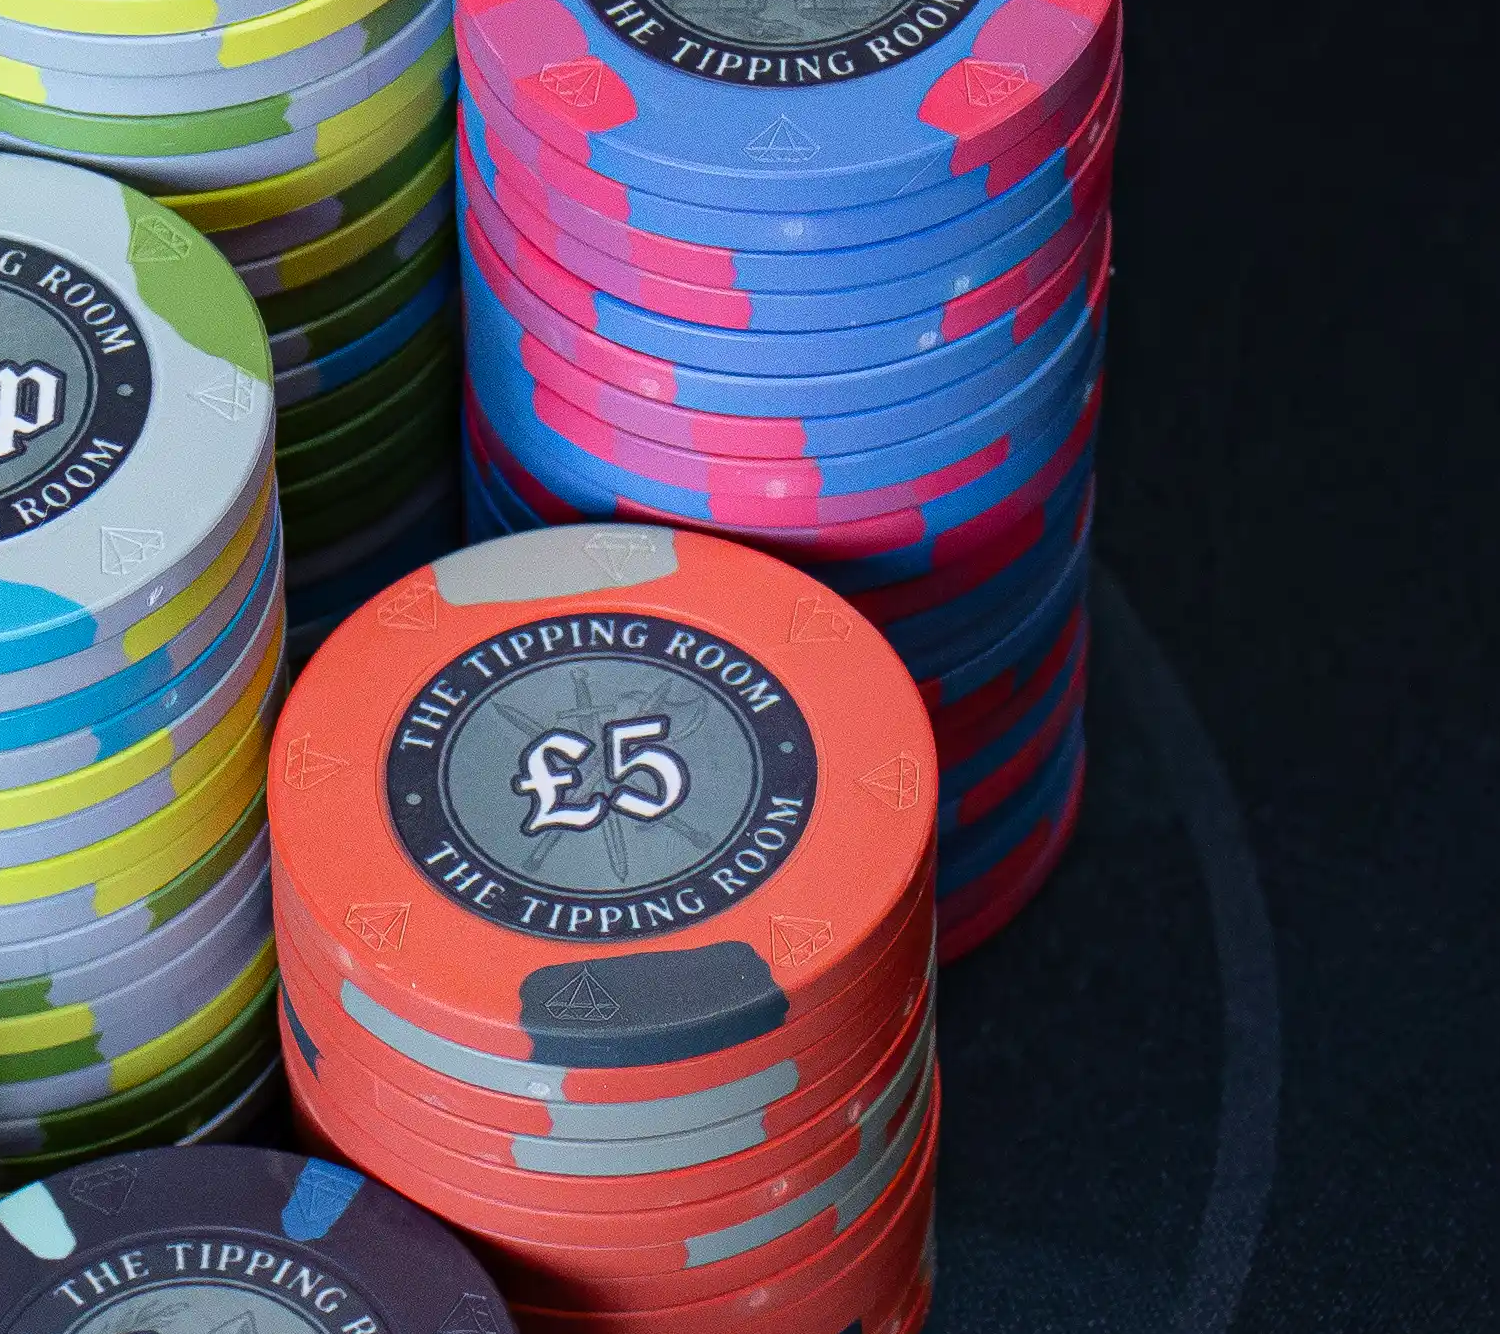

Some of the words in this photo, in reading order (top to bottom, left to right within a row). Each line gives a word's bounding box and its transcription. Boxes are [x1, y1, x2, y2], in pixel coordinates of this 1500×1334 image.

[678, 36, 855, 82] TIPPING
[39, 265, 137, 355] ROOM
[13, 437, 125, 526] ROOM
[399, 682, 468, 751] THE
[466, 619, 648, 679] TIPPING
[668, 630, 781, 714] ROOM
[512, 714, 690, 836] £5
[424, 841, 507, 909] THE
[520, 887, 705, 934] TIPPING
[712, 795, 803, 897] ROOM
[53, 1250, 149, 1308] THE
[166, 1243, 346, 1315] TIPPING
